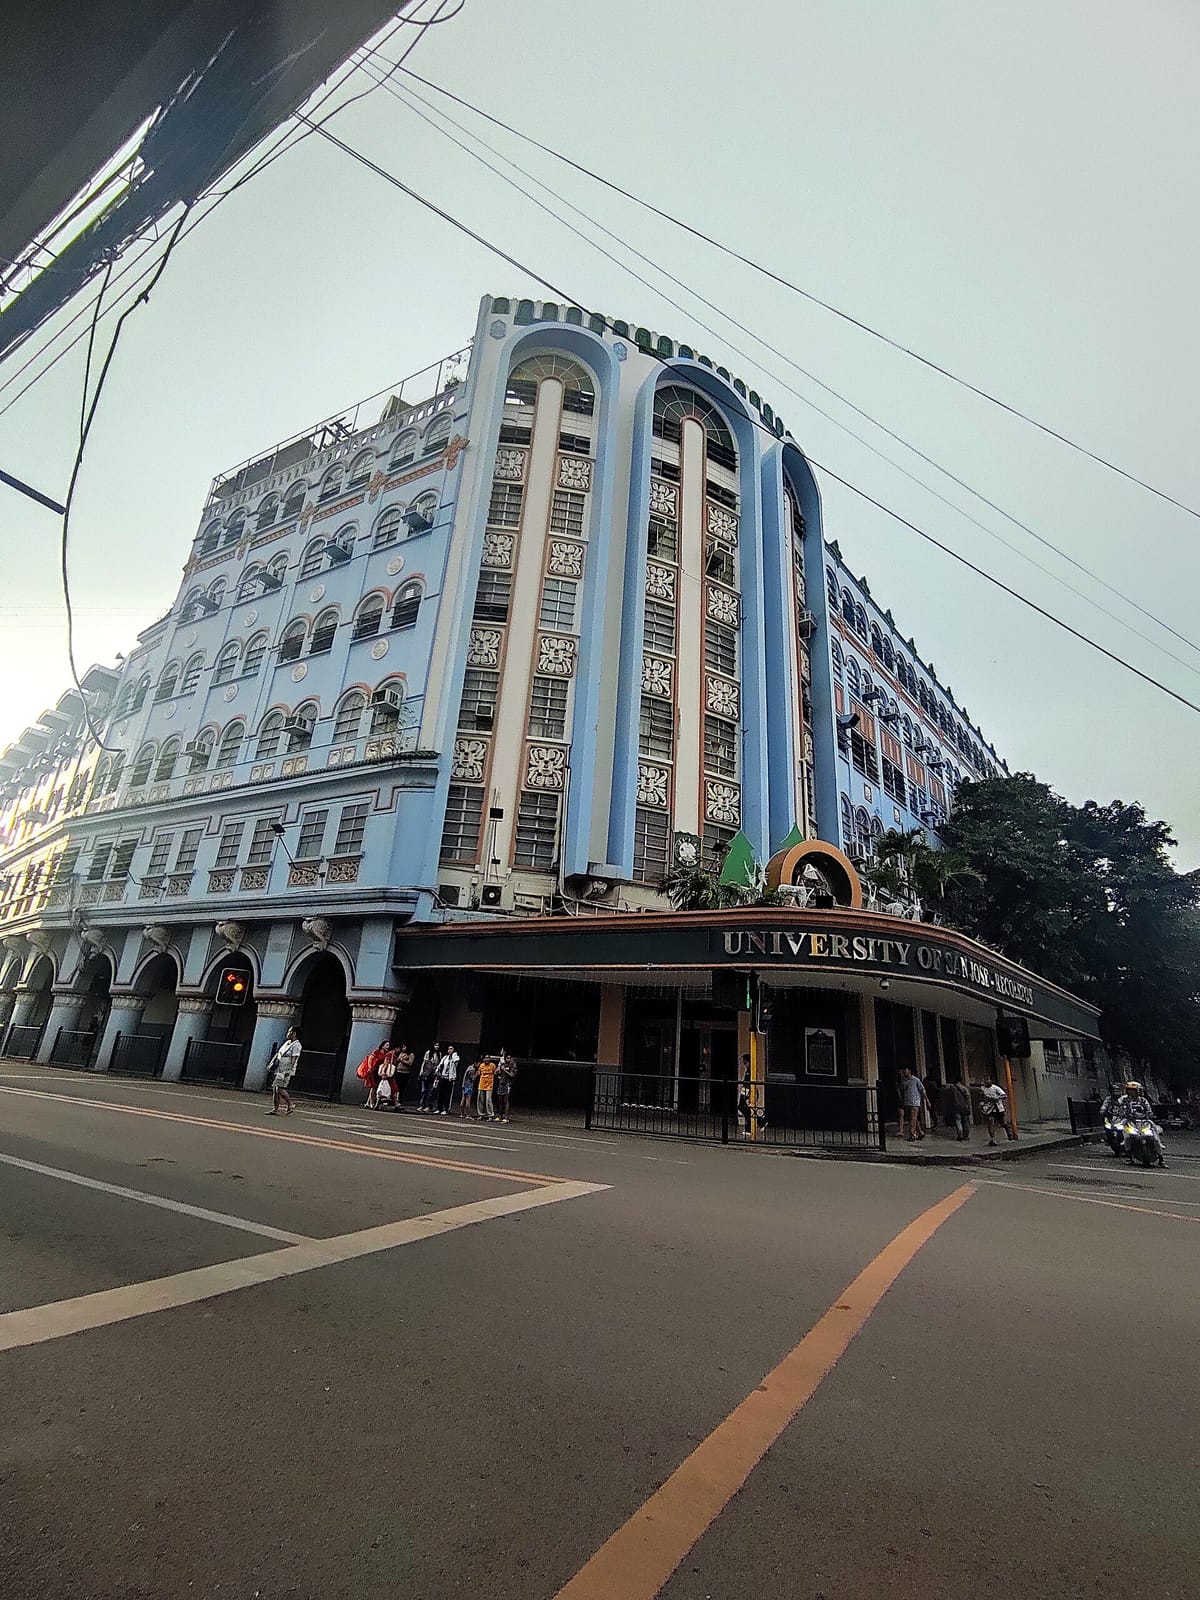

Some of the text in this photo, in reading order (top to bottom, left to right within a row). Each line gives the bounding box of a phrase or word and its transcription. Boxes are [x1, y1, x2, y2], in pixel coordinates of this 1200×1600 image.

[722, 931, 911, 966] UNIVERSITY
[917, 946, 942, 971] OF
[944, 951, 968, 979] SAN
[969, 961, 990, 988] JOSE
